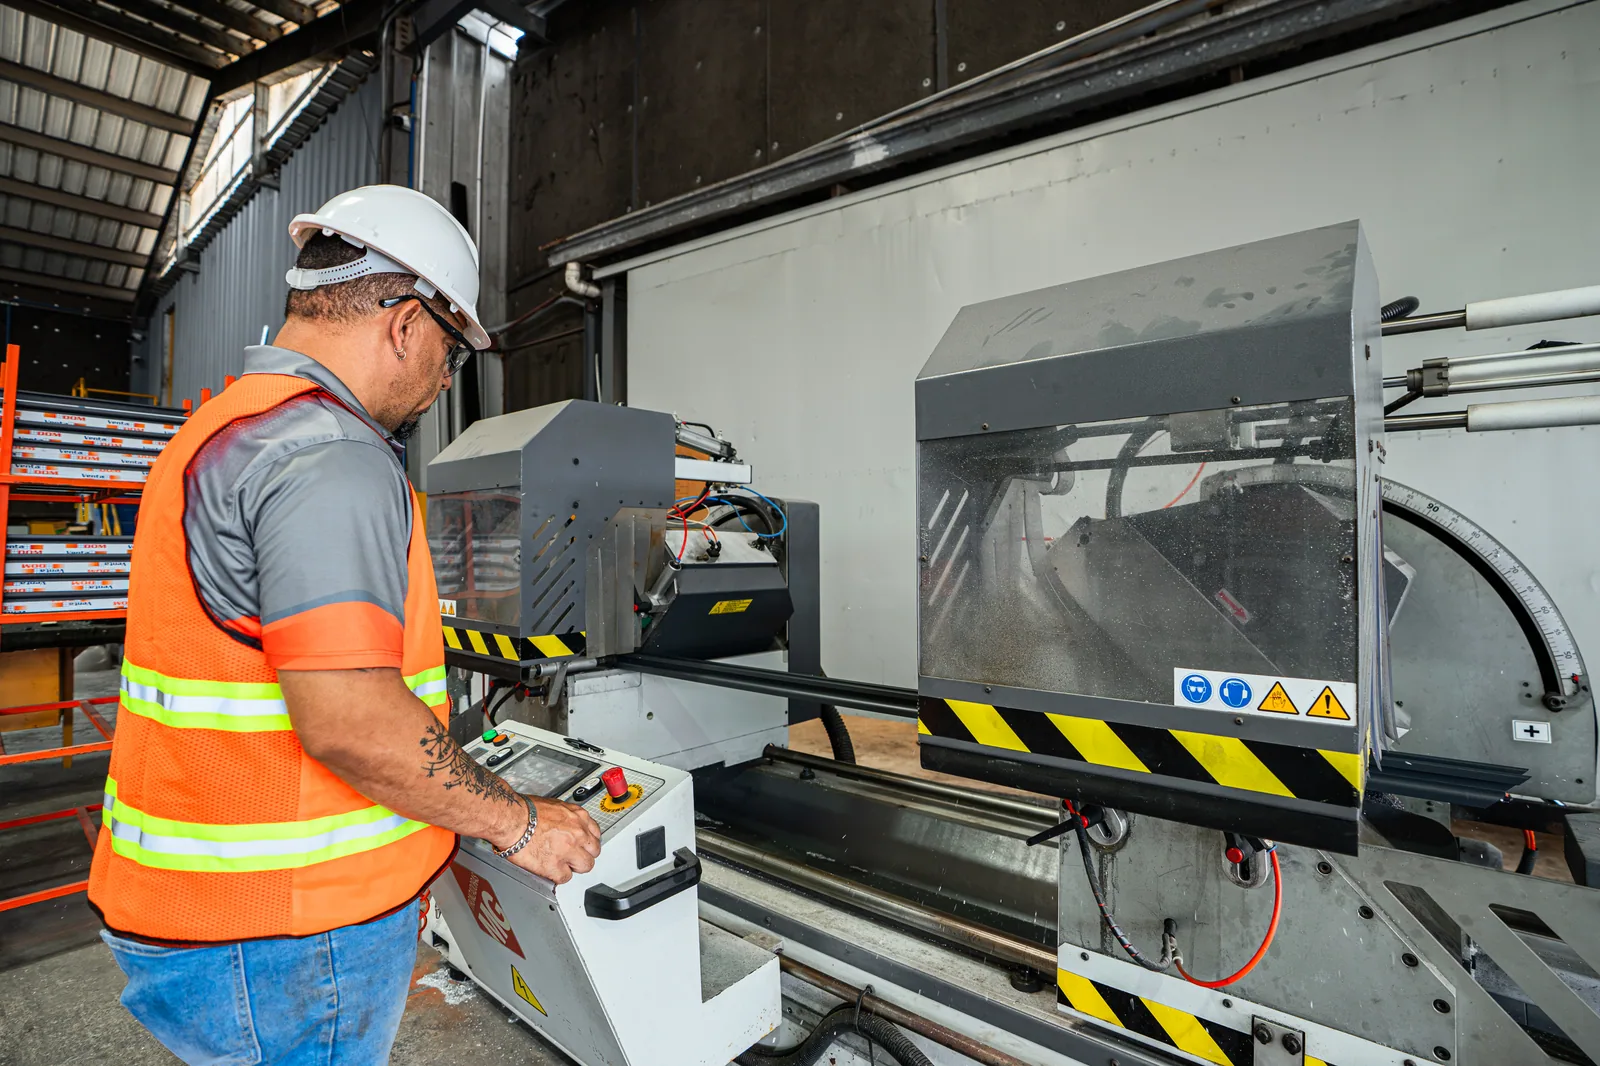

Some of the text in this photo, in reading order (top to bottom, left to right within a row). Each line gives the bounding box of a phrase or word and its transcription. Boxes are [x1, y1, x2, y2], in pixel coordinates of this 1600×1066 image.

[1426, 502, 1440, 513] 90
[1509, 565, 1519, 574] 70
[1540, 606, 1550, 614] 60
[1563, 650, 1573, 660] 50
[478, 890, 511, 945] MG
